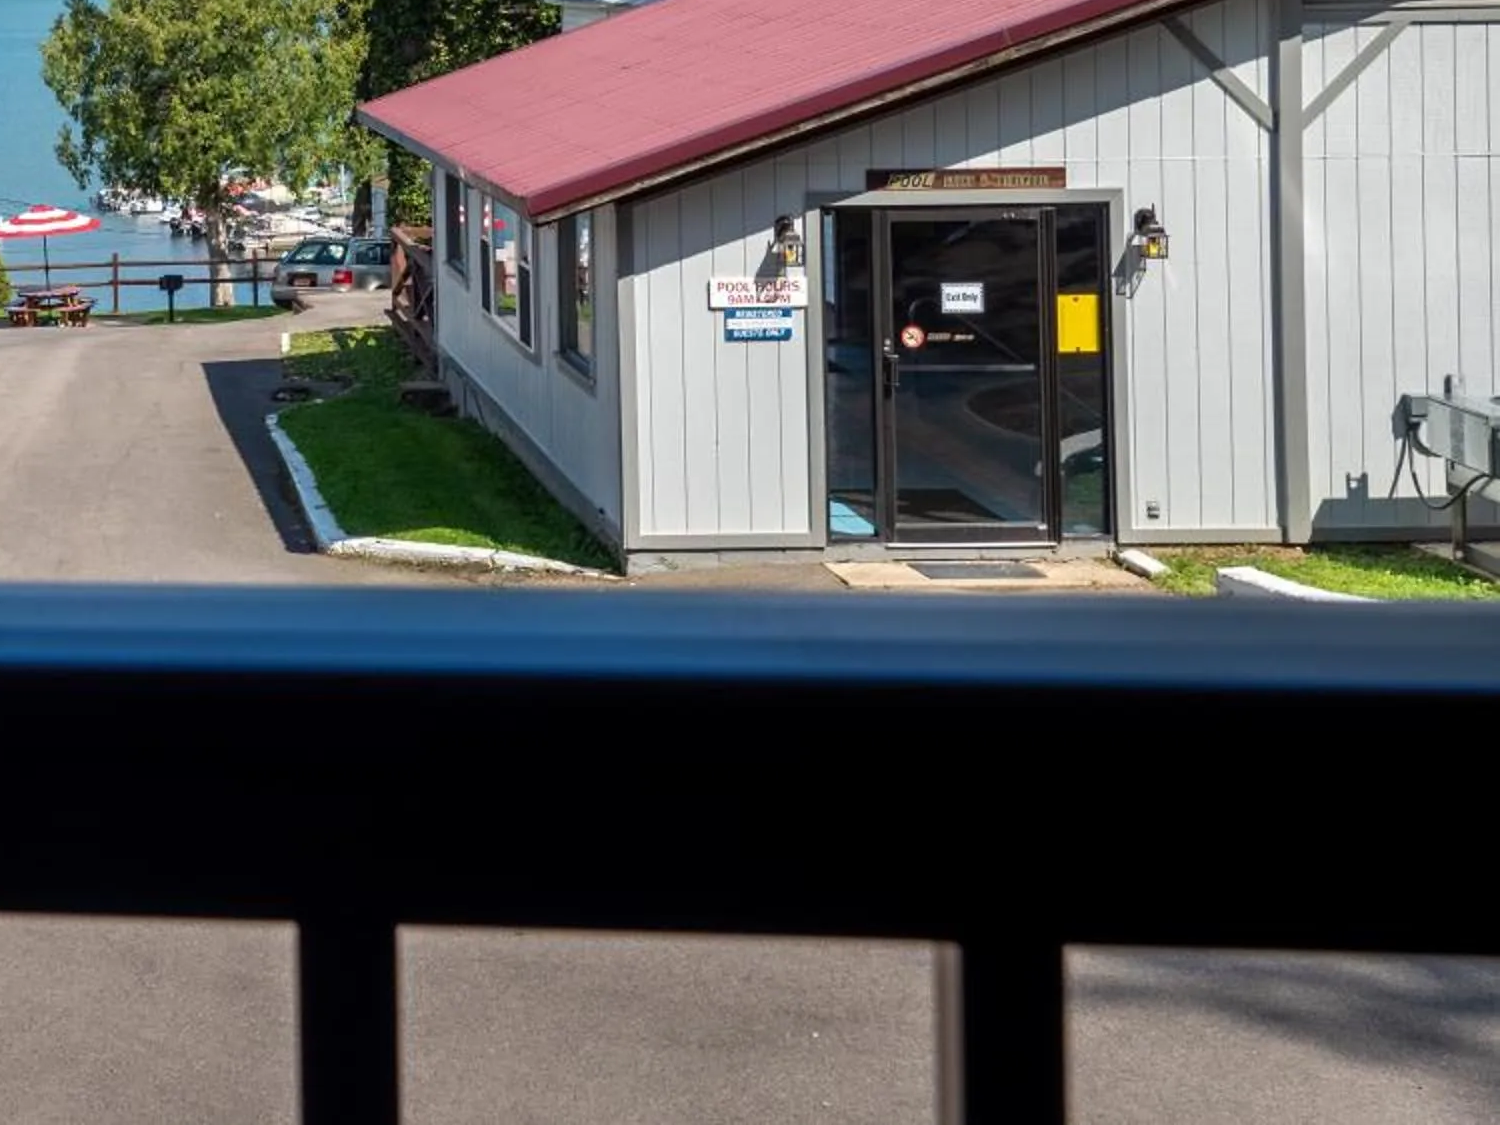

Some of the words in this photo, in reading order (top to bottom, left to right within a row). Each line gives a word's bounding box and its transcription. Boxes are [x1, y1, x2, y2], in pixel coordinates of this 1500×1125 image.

[888, 172, 934, 188] POOL
[717, 282, 750, 293] POOL
[755, 280, 801, 292] HOURS
